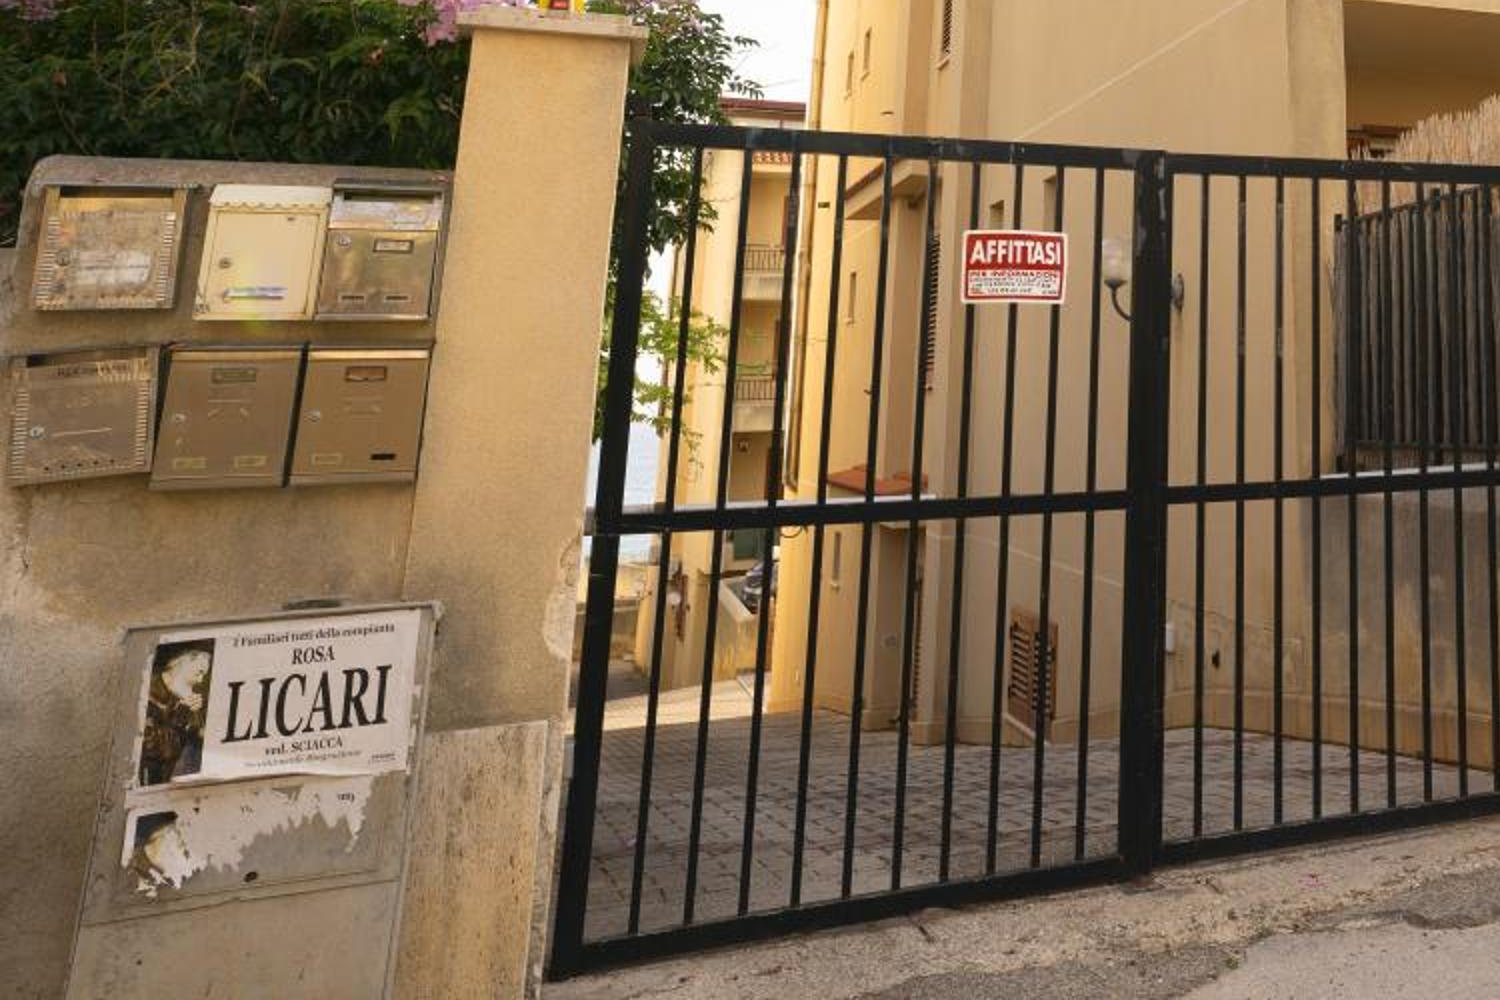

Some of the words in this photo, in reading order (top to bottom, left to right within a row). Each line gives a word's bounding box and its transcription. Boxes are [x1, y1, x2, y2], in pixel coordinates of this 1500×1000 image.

[969, 239, 1061, 265] AFFITTASI
[315, 627, 341, 640] della
[291, 645, 336, 665] ROSA
[221, 663, 393, 744] LICARI
[290, 735, 343, 753] SCIACCA
